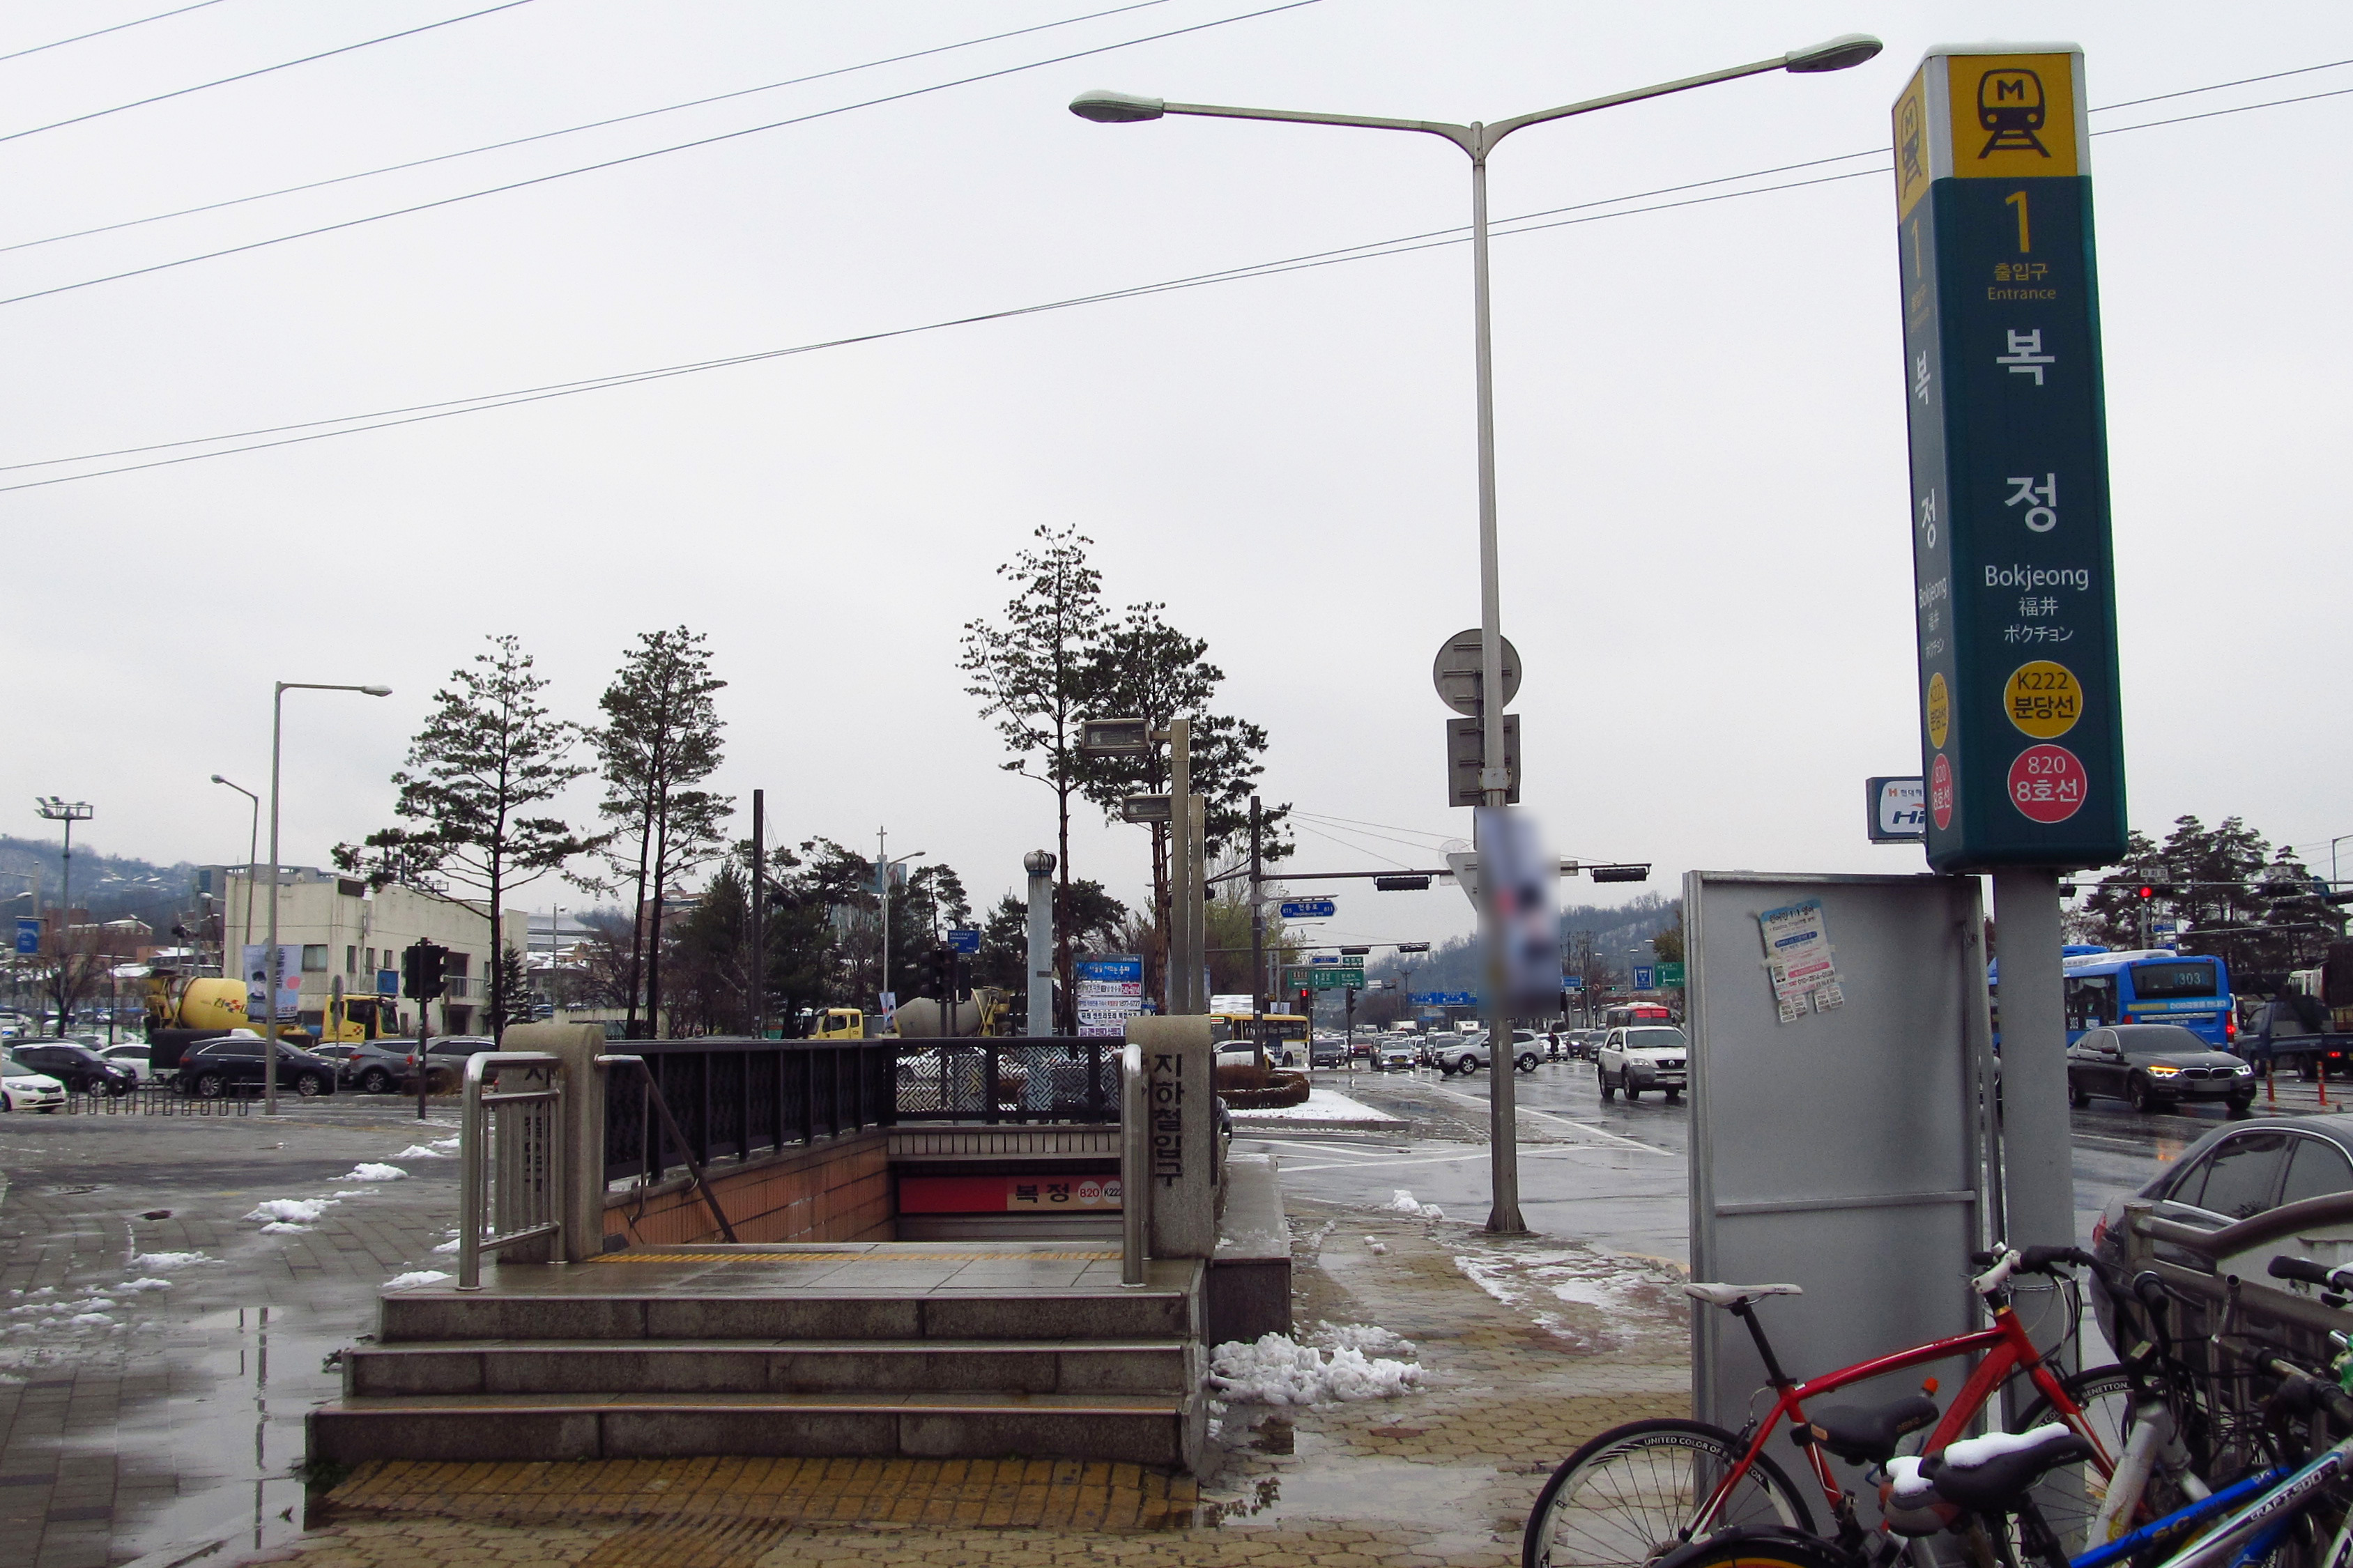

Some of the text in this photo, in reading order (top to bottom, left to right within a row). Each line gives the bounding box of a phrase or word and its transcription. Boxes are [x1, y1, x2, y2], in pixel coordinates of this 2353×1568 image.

[1997, 79, 2025, 101] M
[2005, 191, 2031, 254] 1
[1993, 263, 2048, 281] 출입구
[1988, 286, 2056, 300] Entrance
[1985, 564, 2089, 592] Bokjeong
[2018, 596, 2059, 617] 福井
[2005, 624, 2074, 643] ポクチョン
[2017, 672, 2069, 690] K222
[2013, 695, 2075, 719] 분당선
[2028, 756, 2067, 774] 820
[1933, 785, 1951, 810] 8호선
[2016, 778, 2078, 802] 8호선
[2179, 972, 2201, 985] 303
[1153, 1054, 1185, 1186] 지하철입구
[1080, 1188, 1100, 1198] 820
[1644, 1436, 1678, 1446] UNITED
[1679, 1437, 1708, 1450] COLOR
[1710, 1444, 1722, 1455] OF
